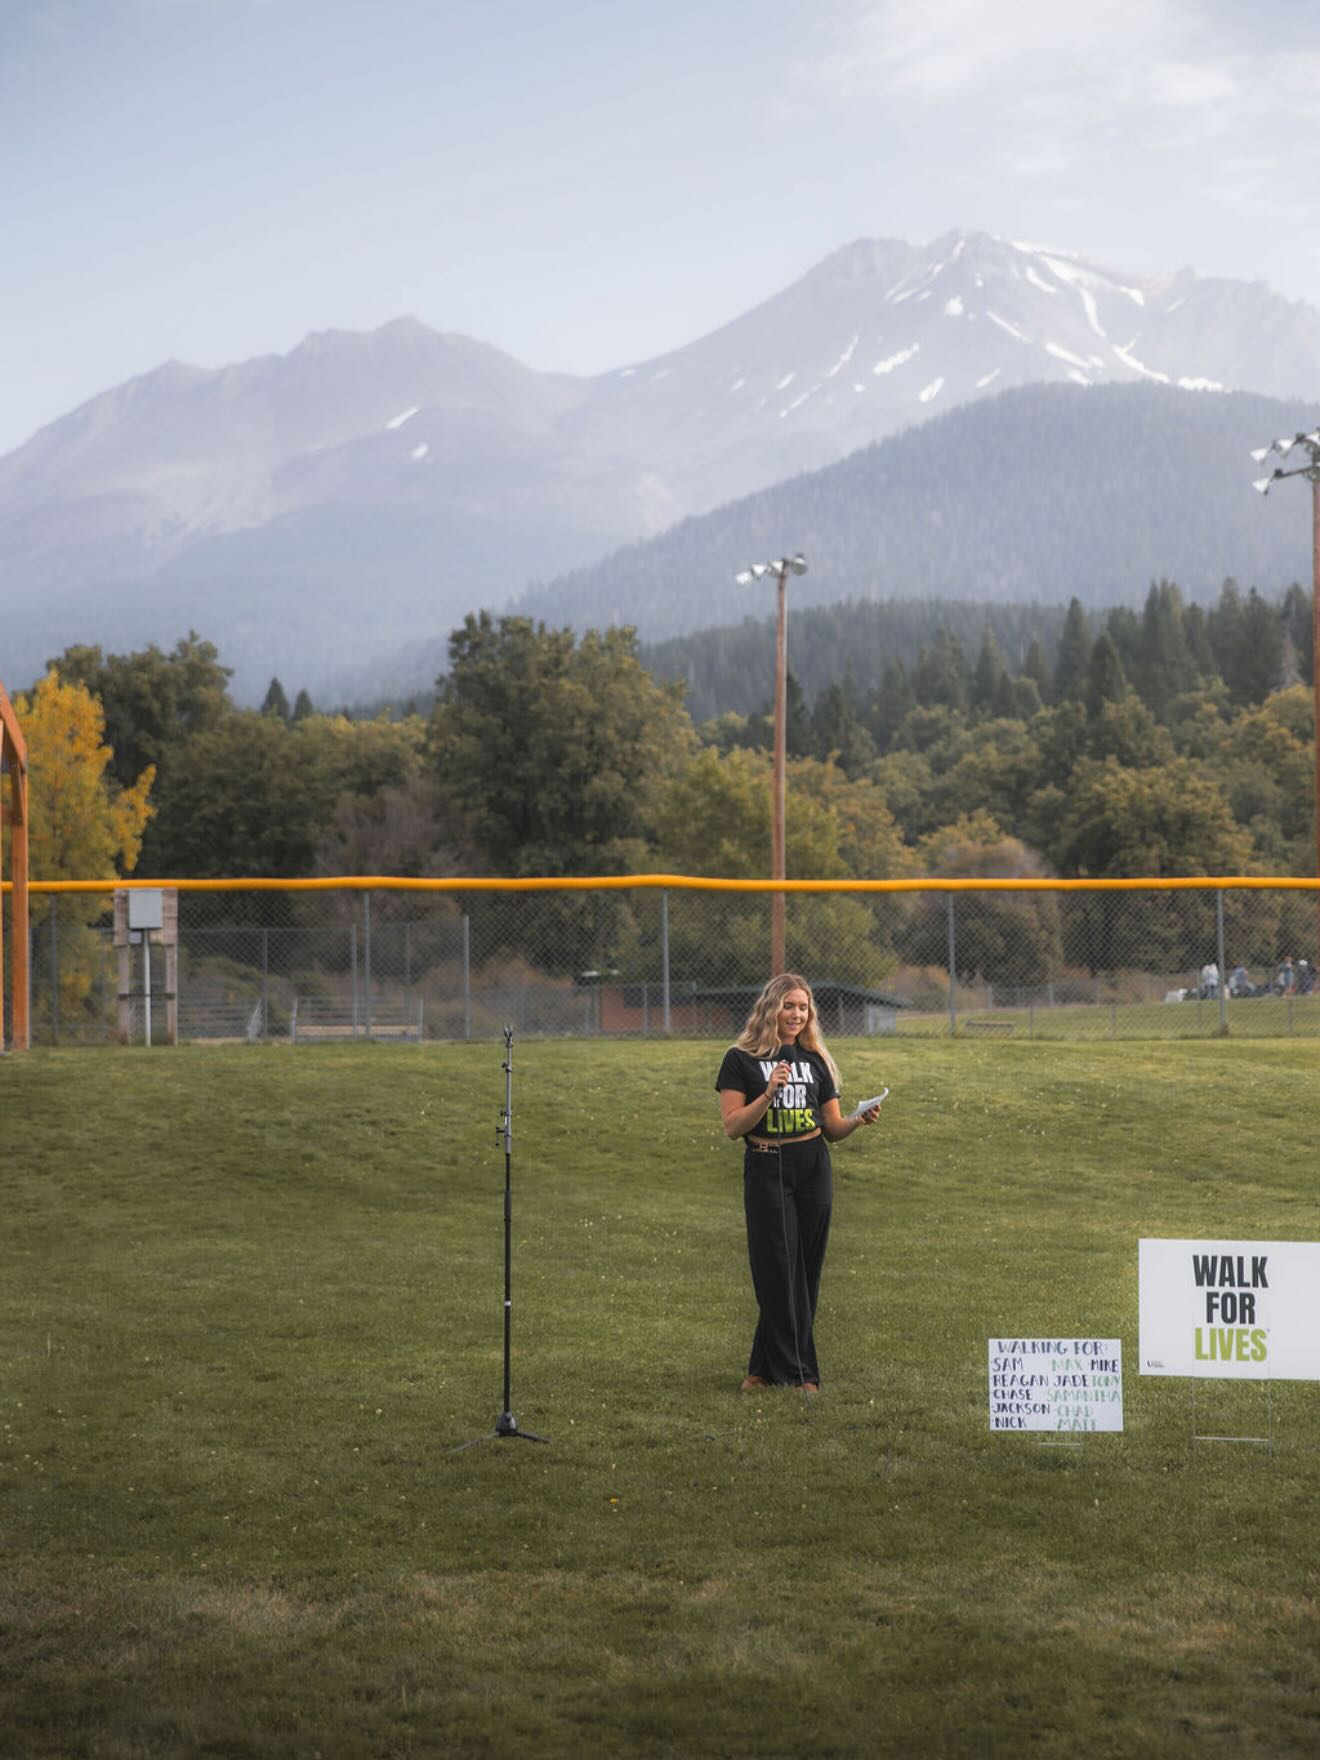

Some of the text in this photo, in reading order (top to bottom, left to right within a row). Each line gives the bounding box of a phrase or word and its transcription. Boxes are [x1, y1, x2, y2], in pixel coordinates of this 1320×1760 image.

[767, 1108, 816, 1133] LIVES
[1192, 1255, 1269, 1288] WALK
[1206, 1291, 1256, 1325] FOR
[998, 1341, 1067, 1355] WALKING
[1195, 1327, 1267, 1362] LIVES
[992, 1357, 1023, 1372] SAM
[1090, 1359, 1119, 1373] MIKE
[993, 1374, 1049, 1387] REAGAN
[1053, 1374, 1088, 1387] JADE
[993, 1389, 1032, 1400] CHASE
[992, 1402, 1050, 1415] JACKSON
[994, 1417, 1027, 1429] NICK
